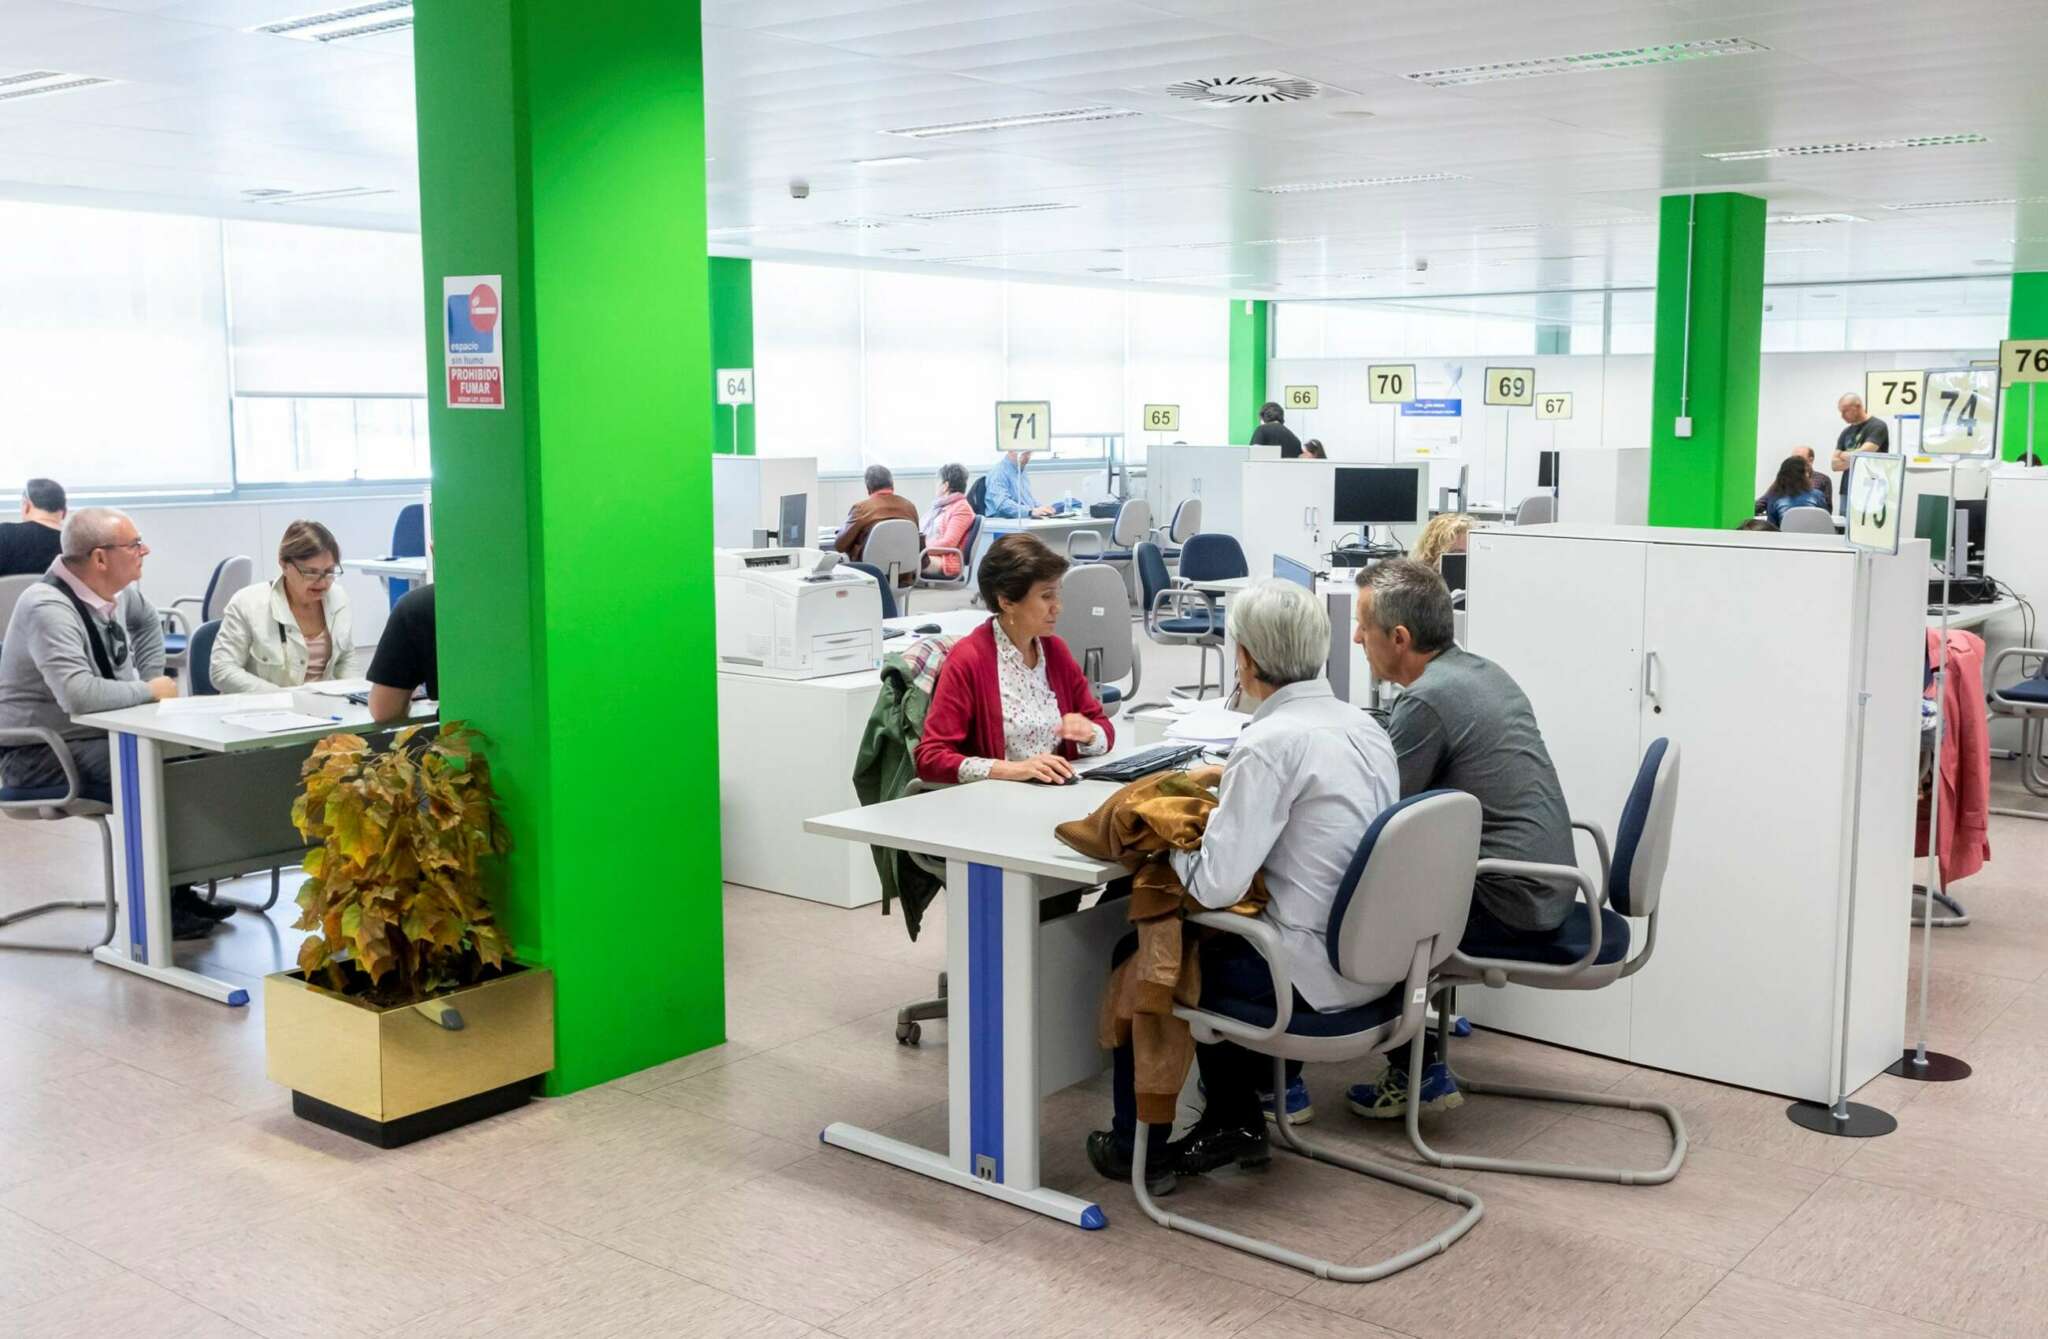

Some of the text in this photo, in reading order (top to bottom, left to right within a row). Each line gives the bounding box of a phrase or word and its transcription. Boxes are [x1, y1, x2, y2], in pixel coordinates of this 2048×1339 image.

[2015, 348, 2048, 373] 76
[451, 368, 498, 380] PROHIBIDO
[460, 382, 491, 394] FUMAR
[727, 377, 746, 396] 64
[1377, 374, 1402, 395] 70
[1499, 376, 1525, 398] 69
[1882, 381, 1917, 405] 75
[1293, 391, 1311, 404] 66
[1545, 398, 1565, 414] 67
[1151, 410, 1170, 425] 65
[1940, 389, 1978, 437] 74
[1010, 412, 1036, 439] 71
